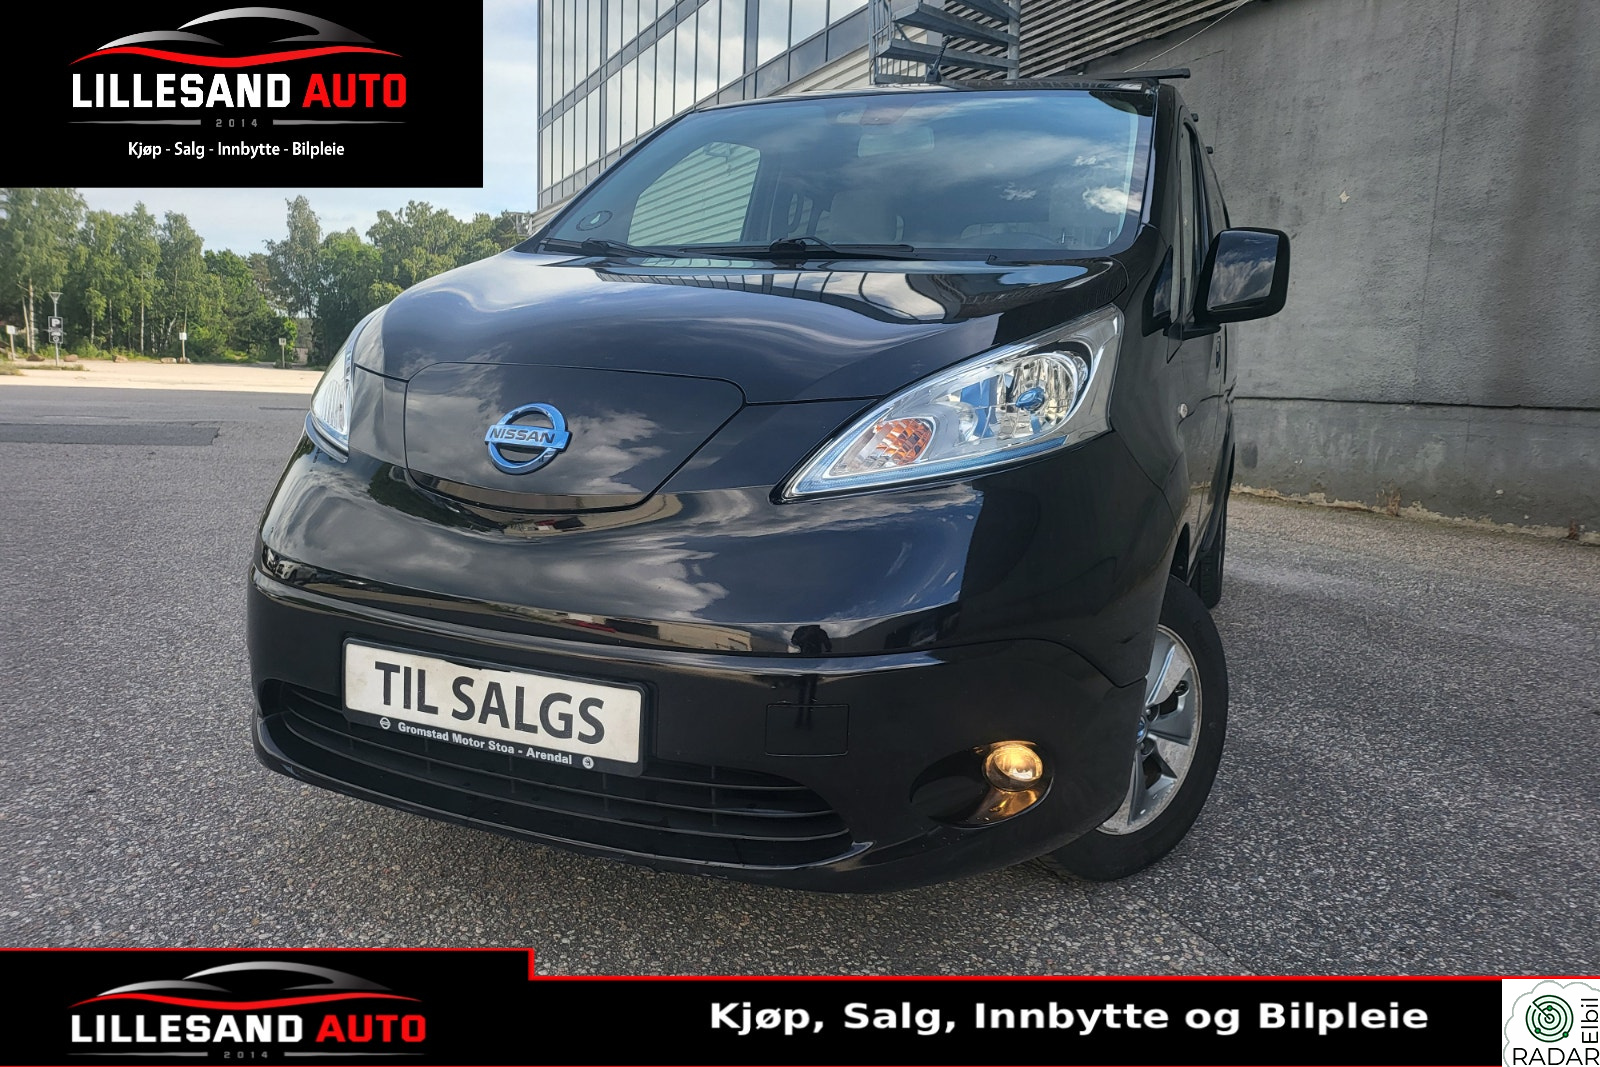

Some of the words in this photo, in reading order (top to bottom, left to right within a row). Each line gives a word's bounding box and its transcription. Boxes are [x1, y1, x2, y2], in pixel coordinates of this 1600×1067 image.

[490, 429, 555, 443] NISSAN
[375, 661, 439, 715] TIL
[451, 676, 605, 744] SALGS
[398, 721, 449, 742] Gromstad
[452, 732, 485, 750] Motor
[488, 739, 515, 754] Stoa
[526, 747, 573, 765] Arendal
